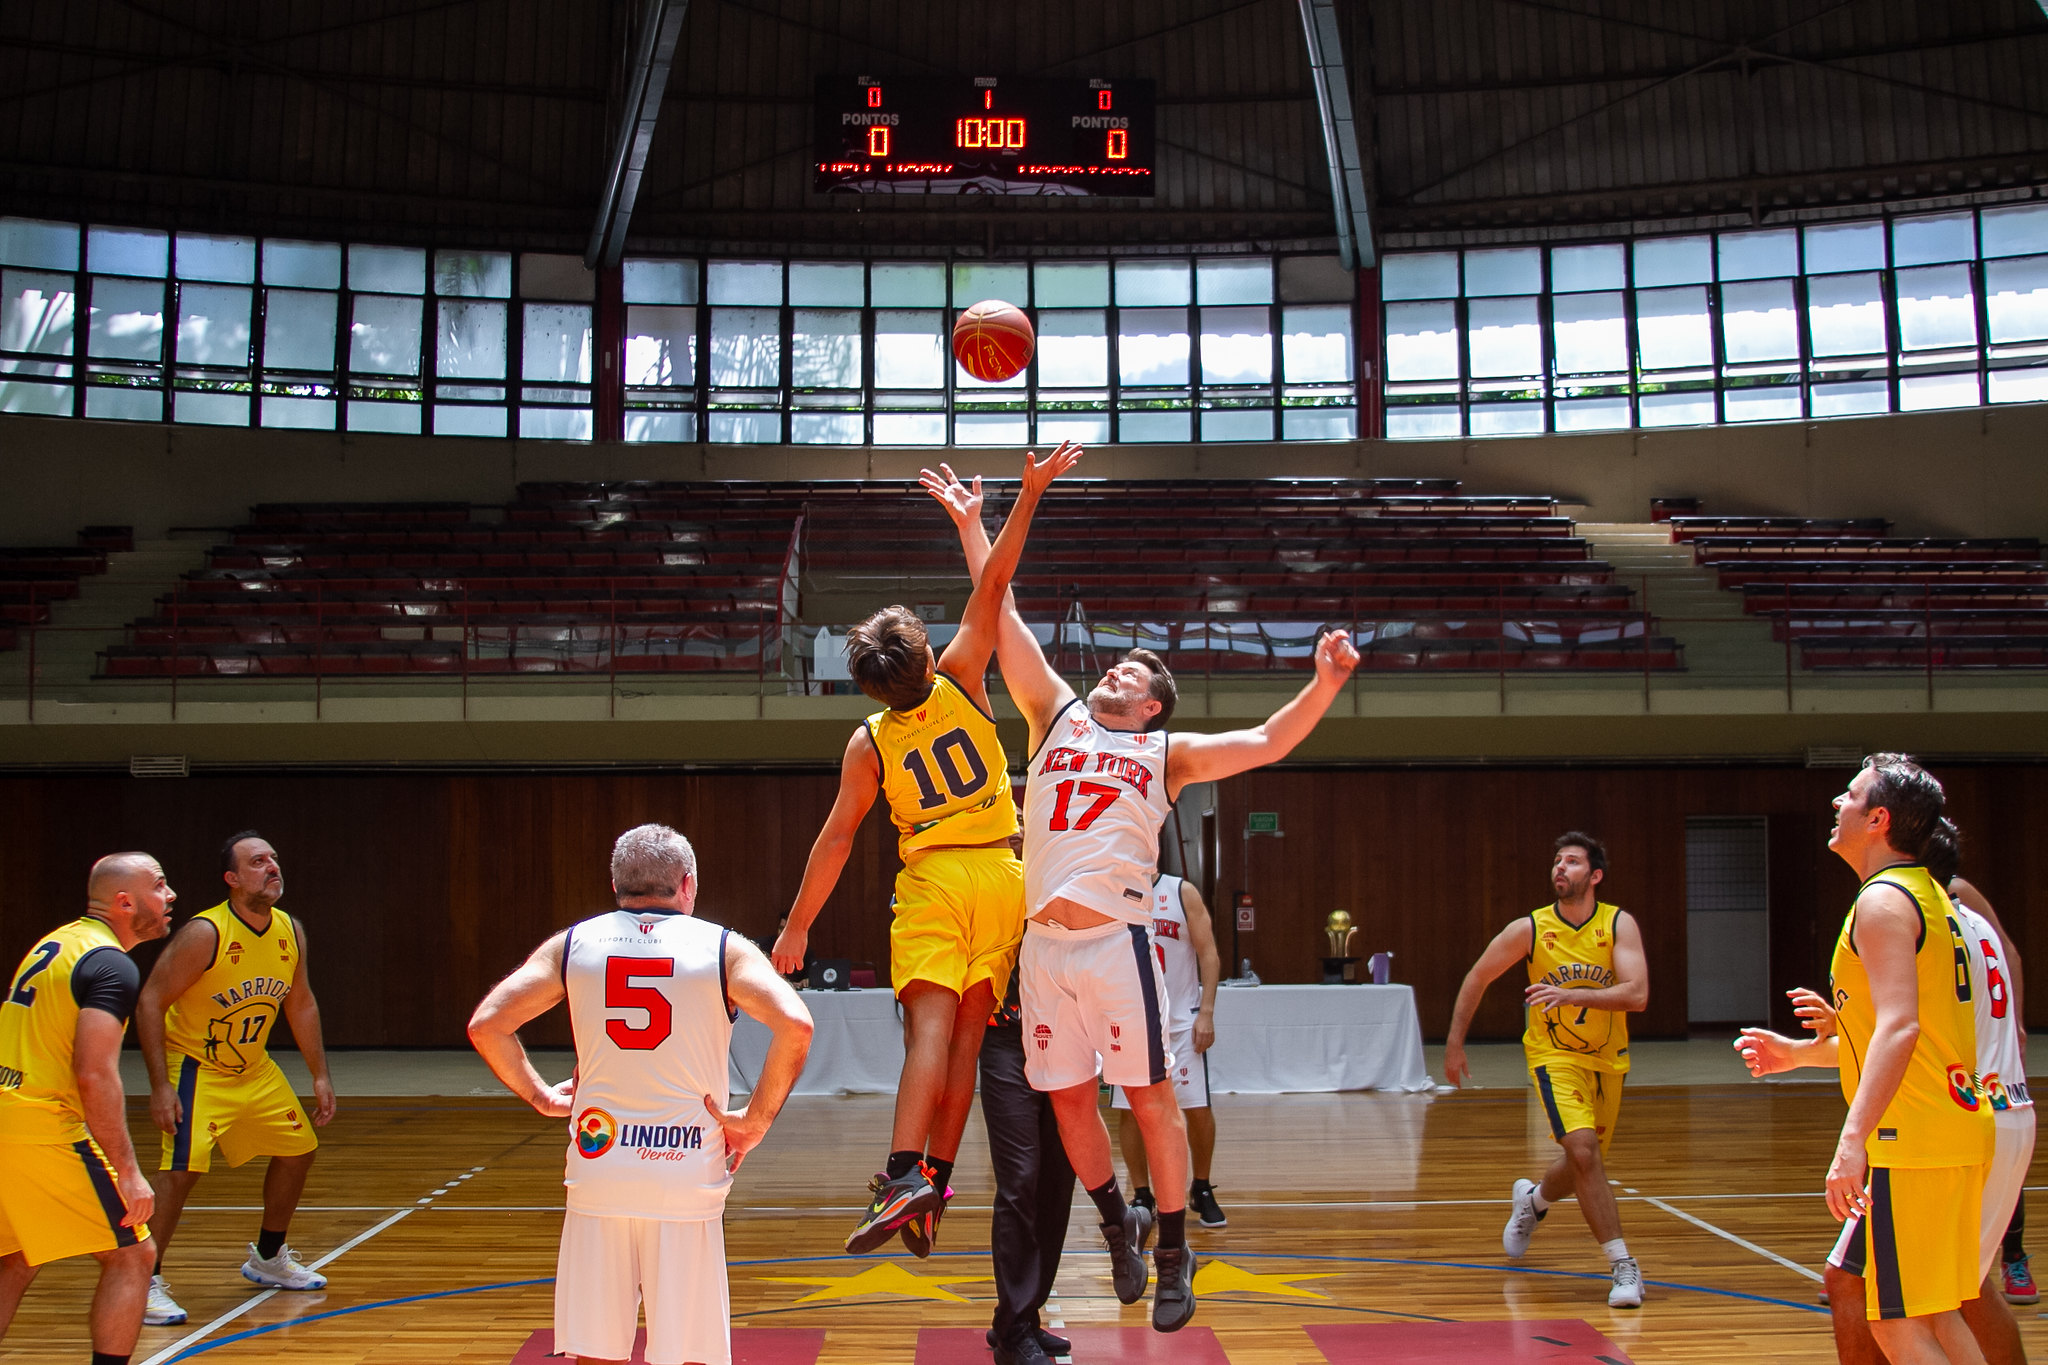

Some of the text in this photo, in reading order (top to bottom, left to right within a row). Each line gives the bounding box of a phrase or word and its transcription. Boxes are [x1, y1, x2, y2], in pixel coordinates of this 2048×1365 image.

[868, 87, 881, 107] 0
[1099, 90, 1111, 110] 0
[842, 113, 899, 126] PONTOS
[956, 119, 1025, 148] 10:00
[1072, 116, 1129, 129] PONTOS
[870, 127, 888, 156] 0
[1107, 130, 1126, 159] 0
[902, 727, 989, 810] 10
[1038, 748, 1153, 800] NEW YORK
[1049, 779, 1121, 831] 17
[605, 955, 674, 1050] 5
[238, 1013, 268, 1045] 17
[620, 1124, 702, 1150] LINDOYA
[636, 1146, 687, 1162] Verão
